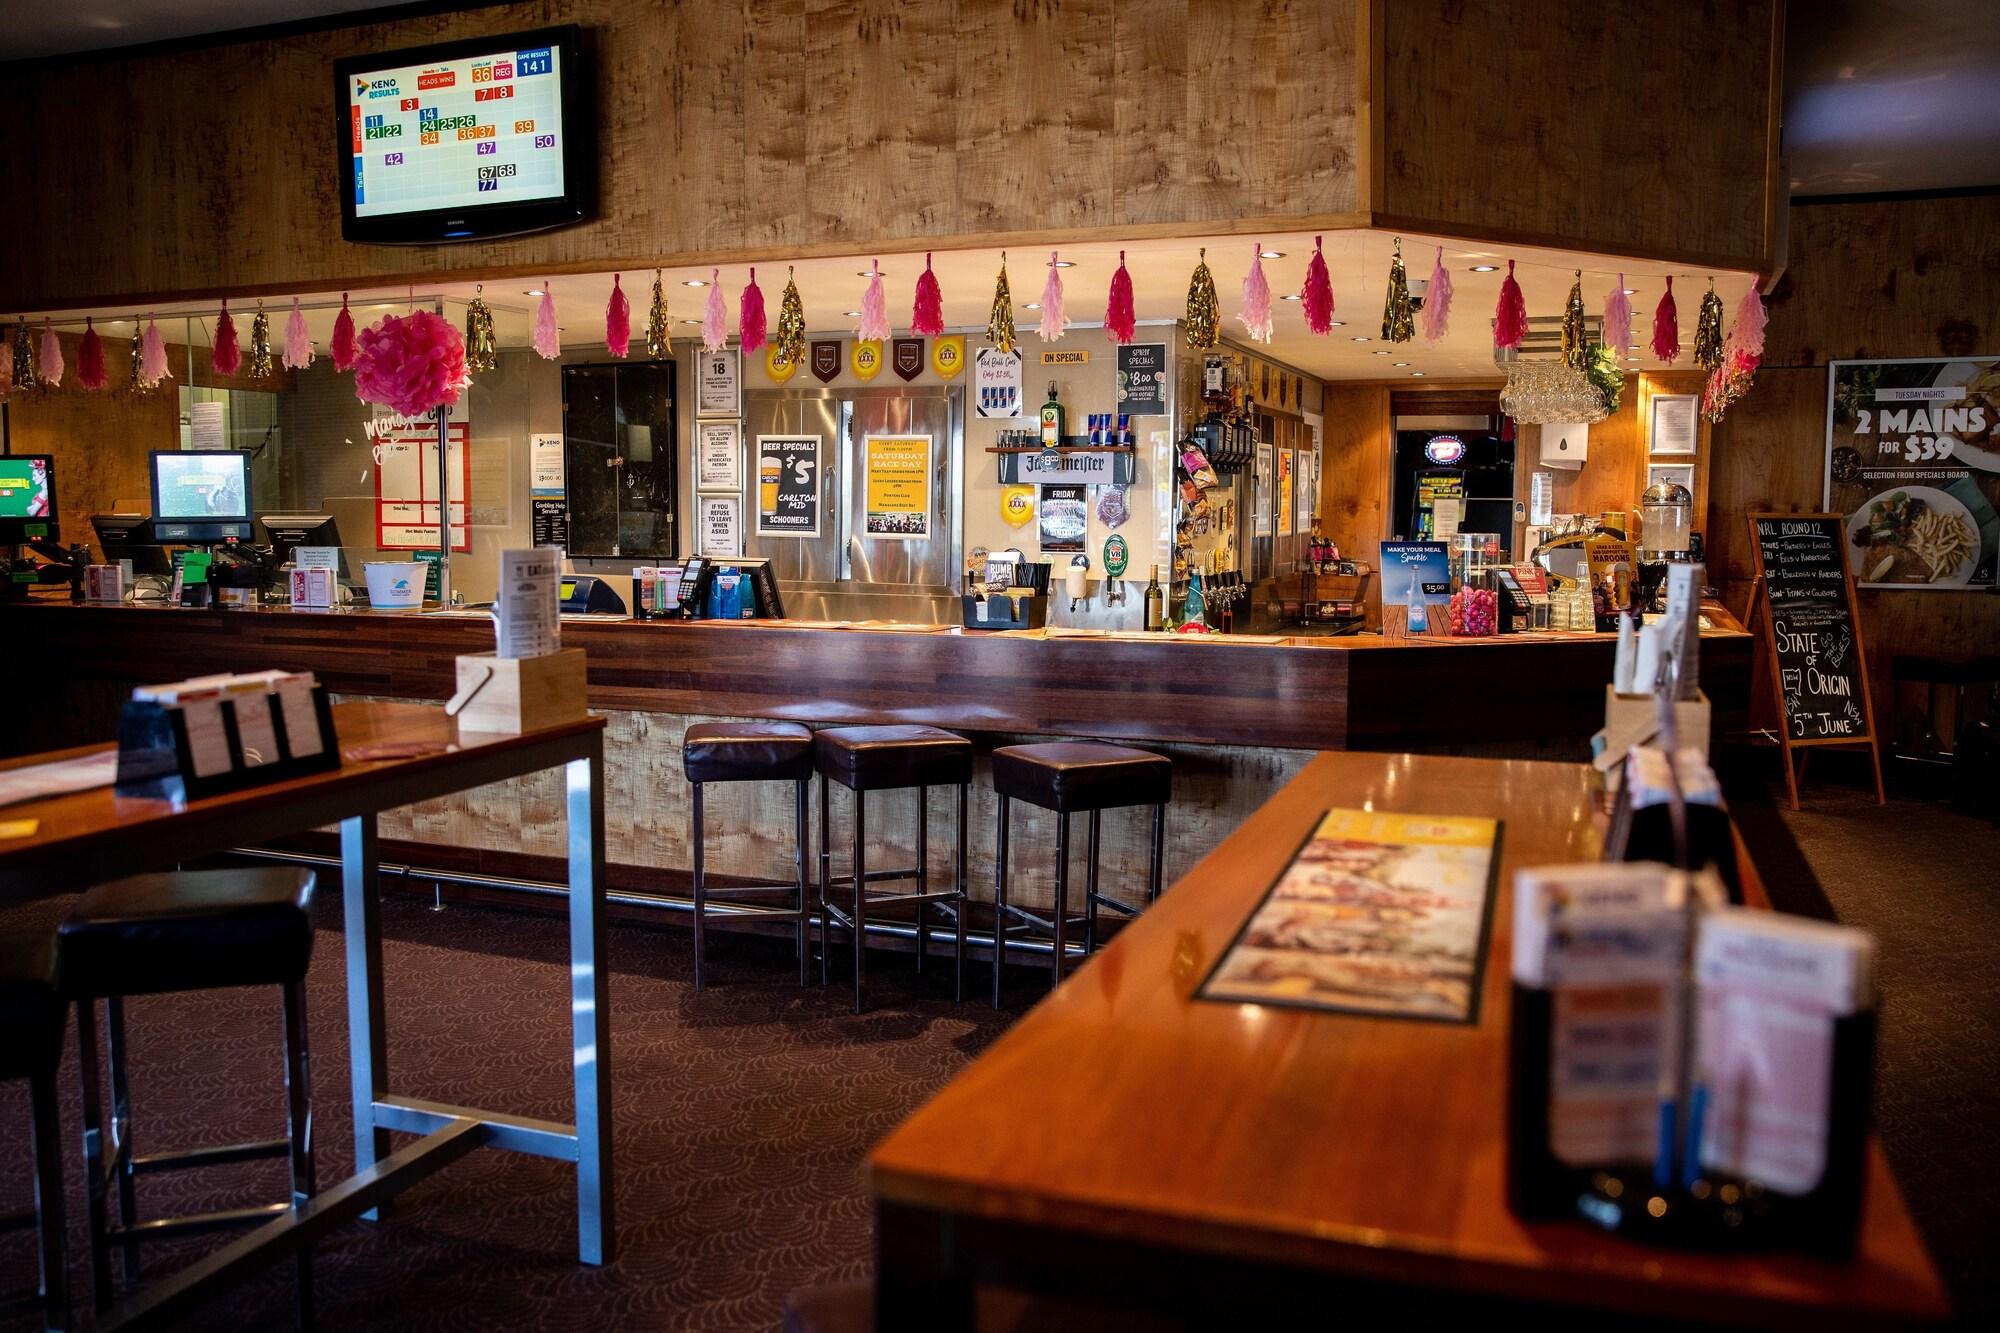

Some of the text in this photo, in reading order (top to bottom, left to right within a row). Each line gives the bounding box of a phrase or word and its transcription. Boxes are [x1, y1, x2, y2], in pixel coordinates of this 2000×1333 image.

[524, 60, 545, 73] 141
[419, 75, 454, 86] HEADS WINS
[474, 68, 511, 82] 36 REG
[372, 79, 396, 89] KENO
[369, 88, 400, 99] RESULTS
[481, 87, 508, 100] 7 8
[407, 100, 413, 110] 3
[423, 109, 434, 119] 14
[370, 116, 378, 126] 11
[422, 116, 473, 133] 24 25 26
[517, 121, 532, 132] 39
[369, 126, 399, 139] 21 22
[460, 126, 492, 140] 36 37
[422, 133, 436, 144] 34
[537, 136, 552, 148] 50
[480, 143, 493, 154] 47
[387, 154, 400, 164] 42
[480, 165, 514, 179] 67 68
[481, 180, 495, 190] 77
[981, 358, 990, 368] Red
[992, 357, 1003, 368] Bull
[1044, 352, 1084, 363] ON SPECIAL
[1129, 357, 1154, 365] SPECIALS
[712, 363, 725, 374] 18
[1923, 390, 1945, 398] NIGHTS
[1854, 407, 1987, 434] 2 MAINS
[1879, 435, 1955, 462] FOR $39
[769, 516, 809, 524] SCHOONERS
[1757, 522, 1824, 536] NRL ROUND 12
[1401, 553, 1428, 563] Sparkle
[1765, 570, 1776, 578] SAT
[1819, 570, 1842, 579] RAIDERS
[1785, 588, 1805, 597] TITANS
[1811, 588, 1837, 597] COWBOYS
[1775, 620, 1820, 654] STATE
[1820, 632, 1833, 647] GO
[1824, 642, 1838, 659] THE
[1806, 655, 1817, 666] OF
[1807, 668, 1851, 697] ORIGIN
[1784, 694, 1800, 717] NSW
[1844, 700, 1863, 726] NSW
[1794, 712, 1853, 736] 5TH JUNE
